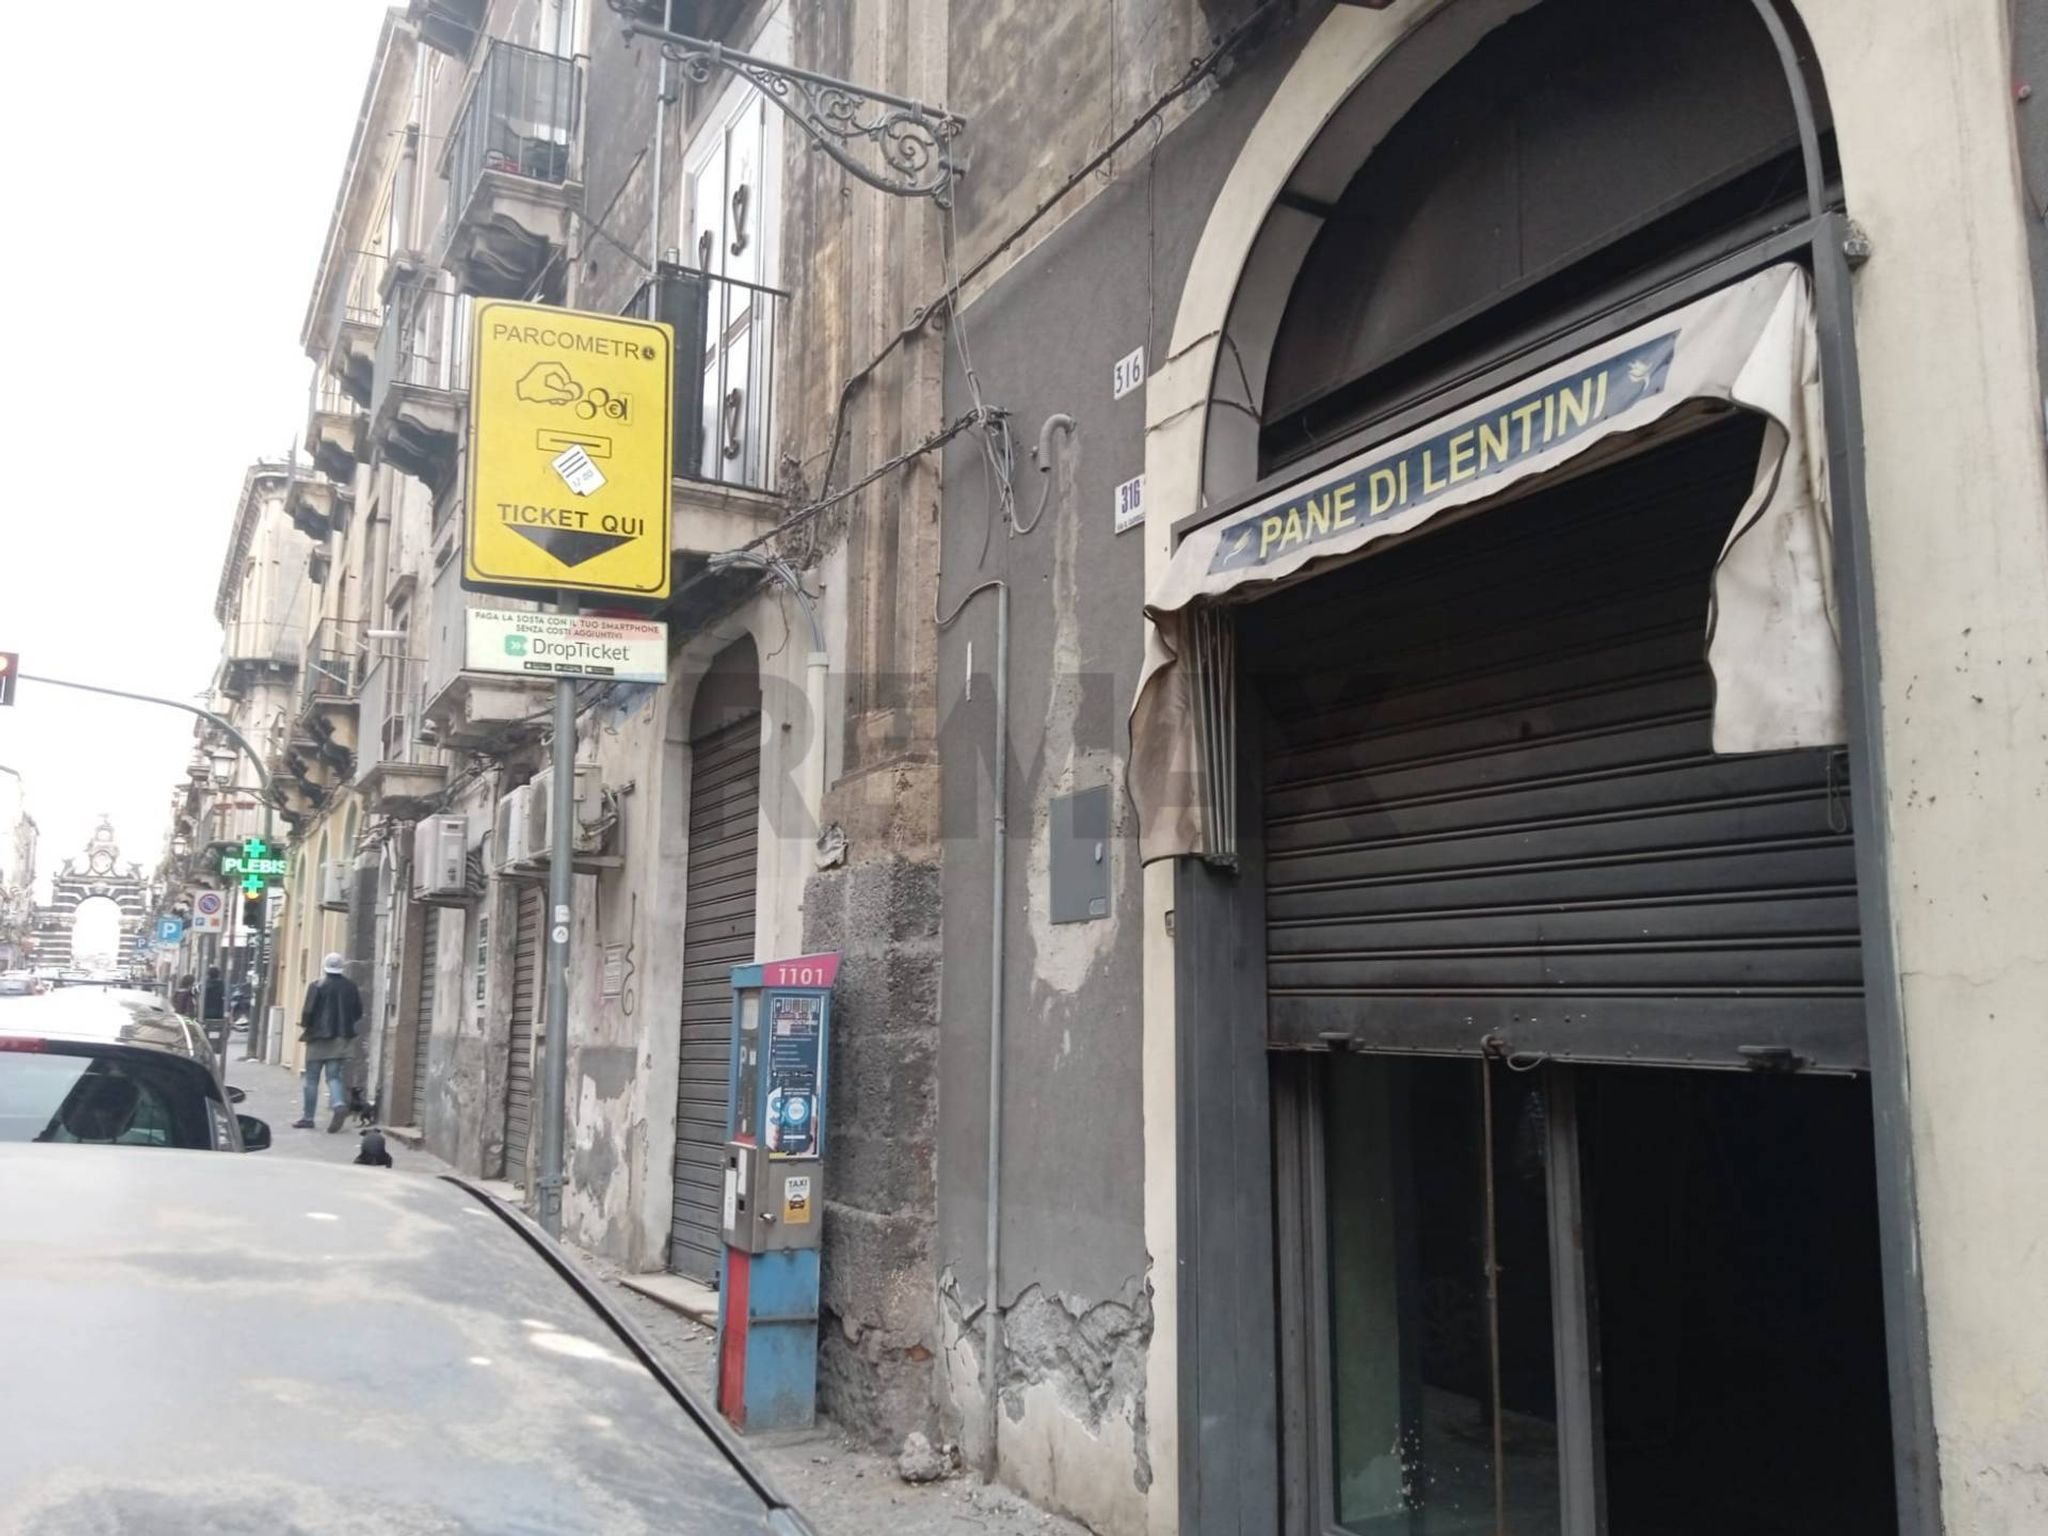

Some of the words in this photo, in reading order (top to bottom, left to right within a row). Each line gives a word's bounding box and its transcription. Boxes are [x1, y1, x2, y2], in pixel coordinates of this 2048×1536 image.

[1115, 355, 1141, 394] 316
[1259, 482, 1356, 558] PANE
[1369, 461, 1408, 516] DI
[1424, 371, 1608, 492] LENTINI
[1121, 479, 1141, 514] 316
[497, 503, 589, 528] TICKET
[601, 514, 644, 536] QUI
[475, 611, 498, 620] PAGA
[516, 615, 544, 624] SOSTA
[547, 617, 567, 625] CON
[570, 618, 577, 627] IL
[580, 620, 599, 629] TUO
[601, 621, 660, 634] SMARTPHONE
[516, 624, 544, 633] SENZA
[546, 626, 571, 635] COSTI
[574, 630, 623, 639] AGGIUNTIVI
[533, 638, 630, 661] DropTicket
[163, 922, 177, 938] P
[778, 967, 823, 985] 1101
[788, 1179, 808, 1188] TAXI
